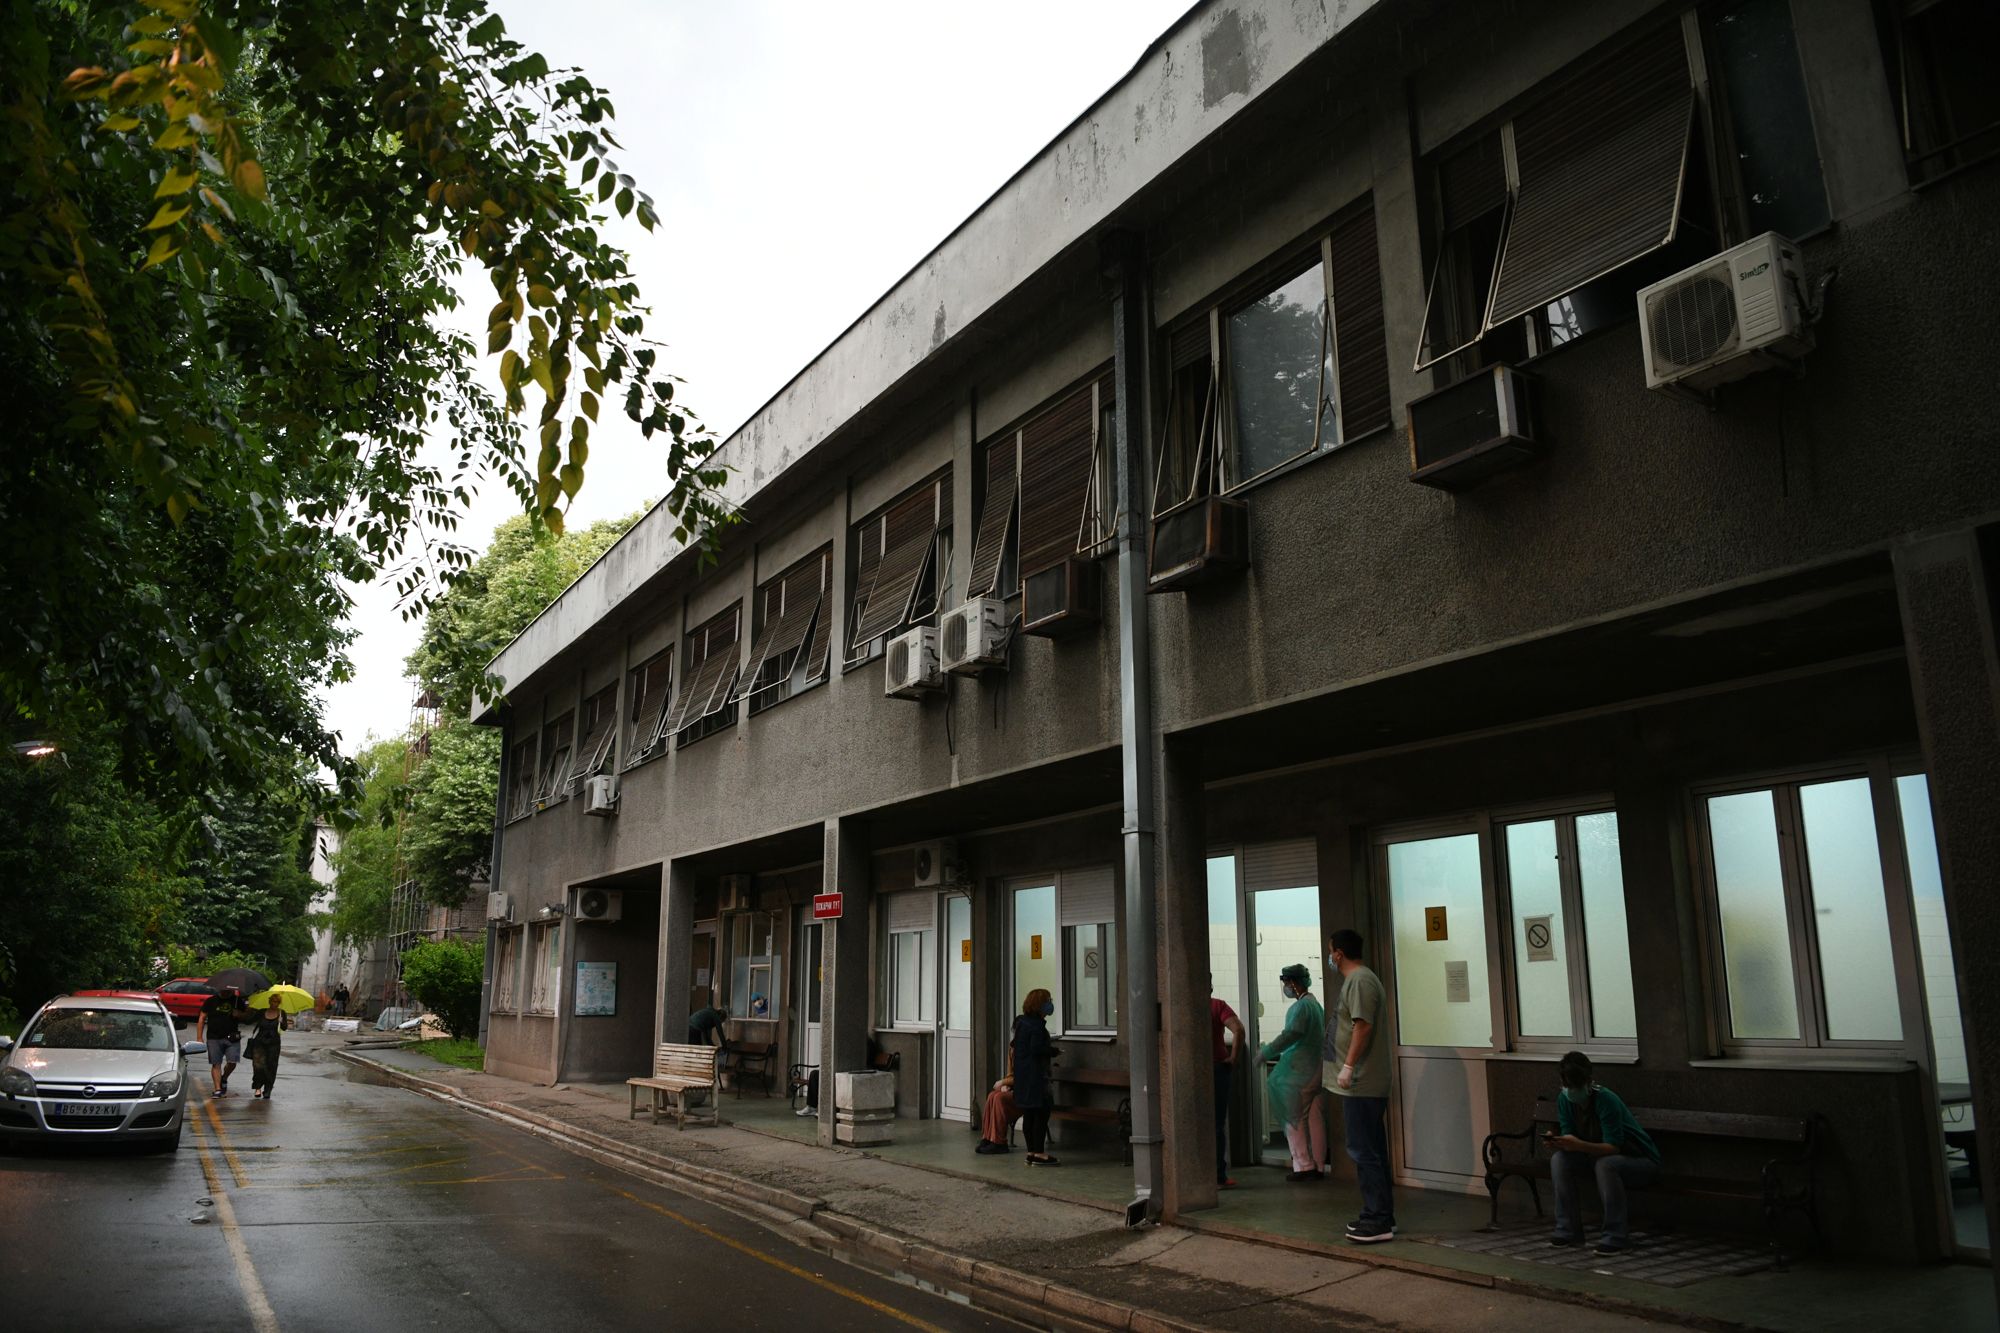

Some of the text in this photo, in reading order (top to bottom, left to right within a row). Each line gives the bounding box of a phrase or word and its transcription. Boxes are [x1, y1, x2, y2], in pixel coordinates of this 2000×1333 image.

[1432, 916, 1440, 931] 5
[964, 946, 969, 956] 2
[1034, 942, 1039, 952] 3
